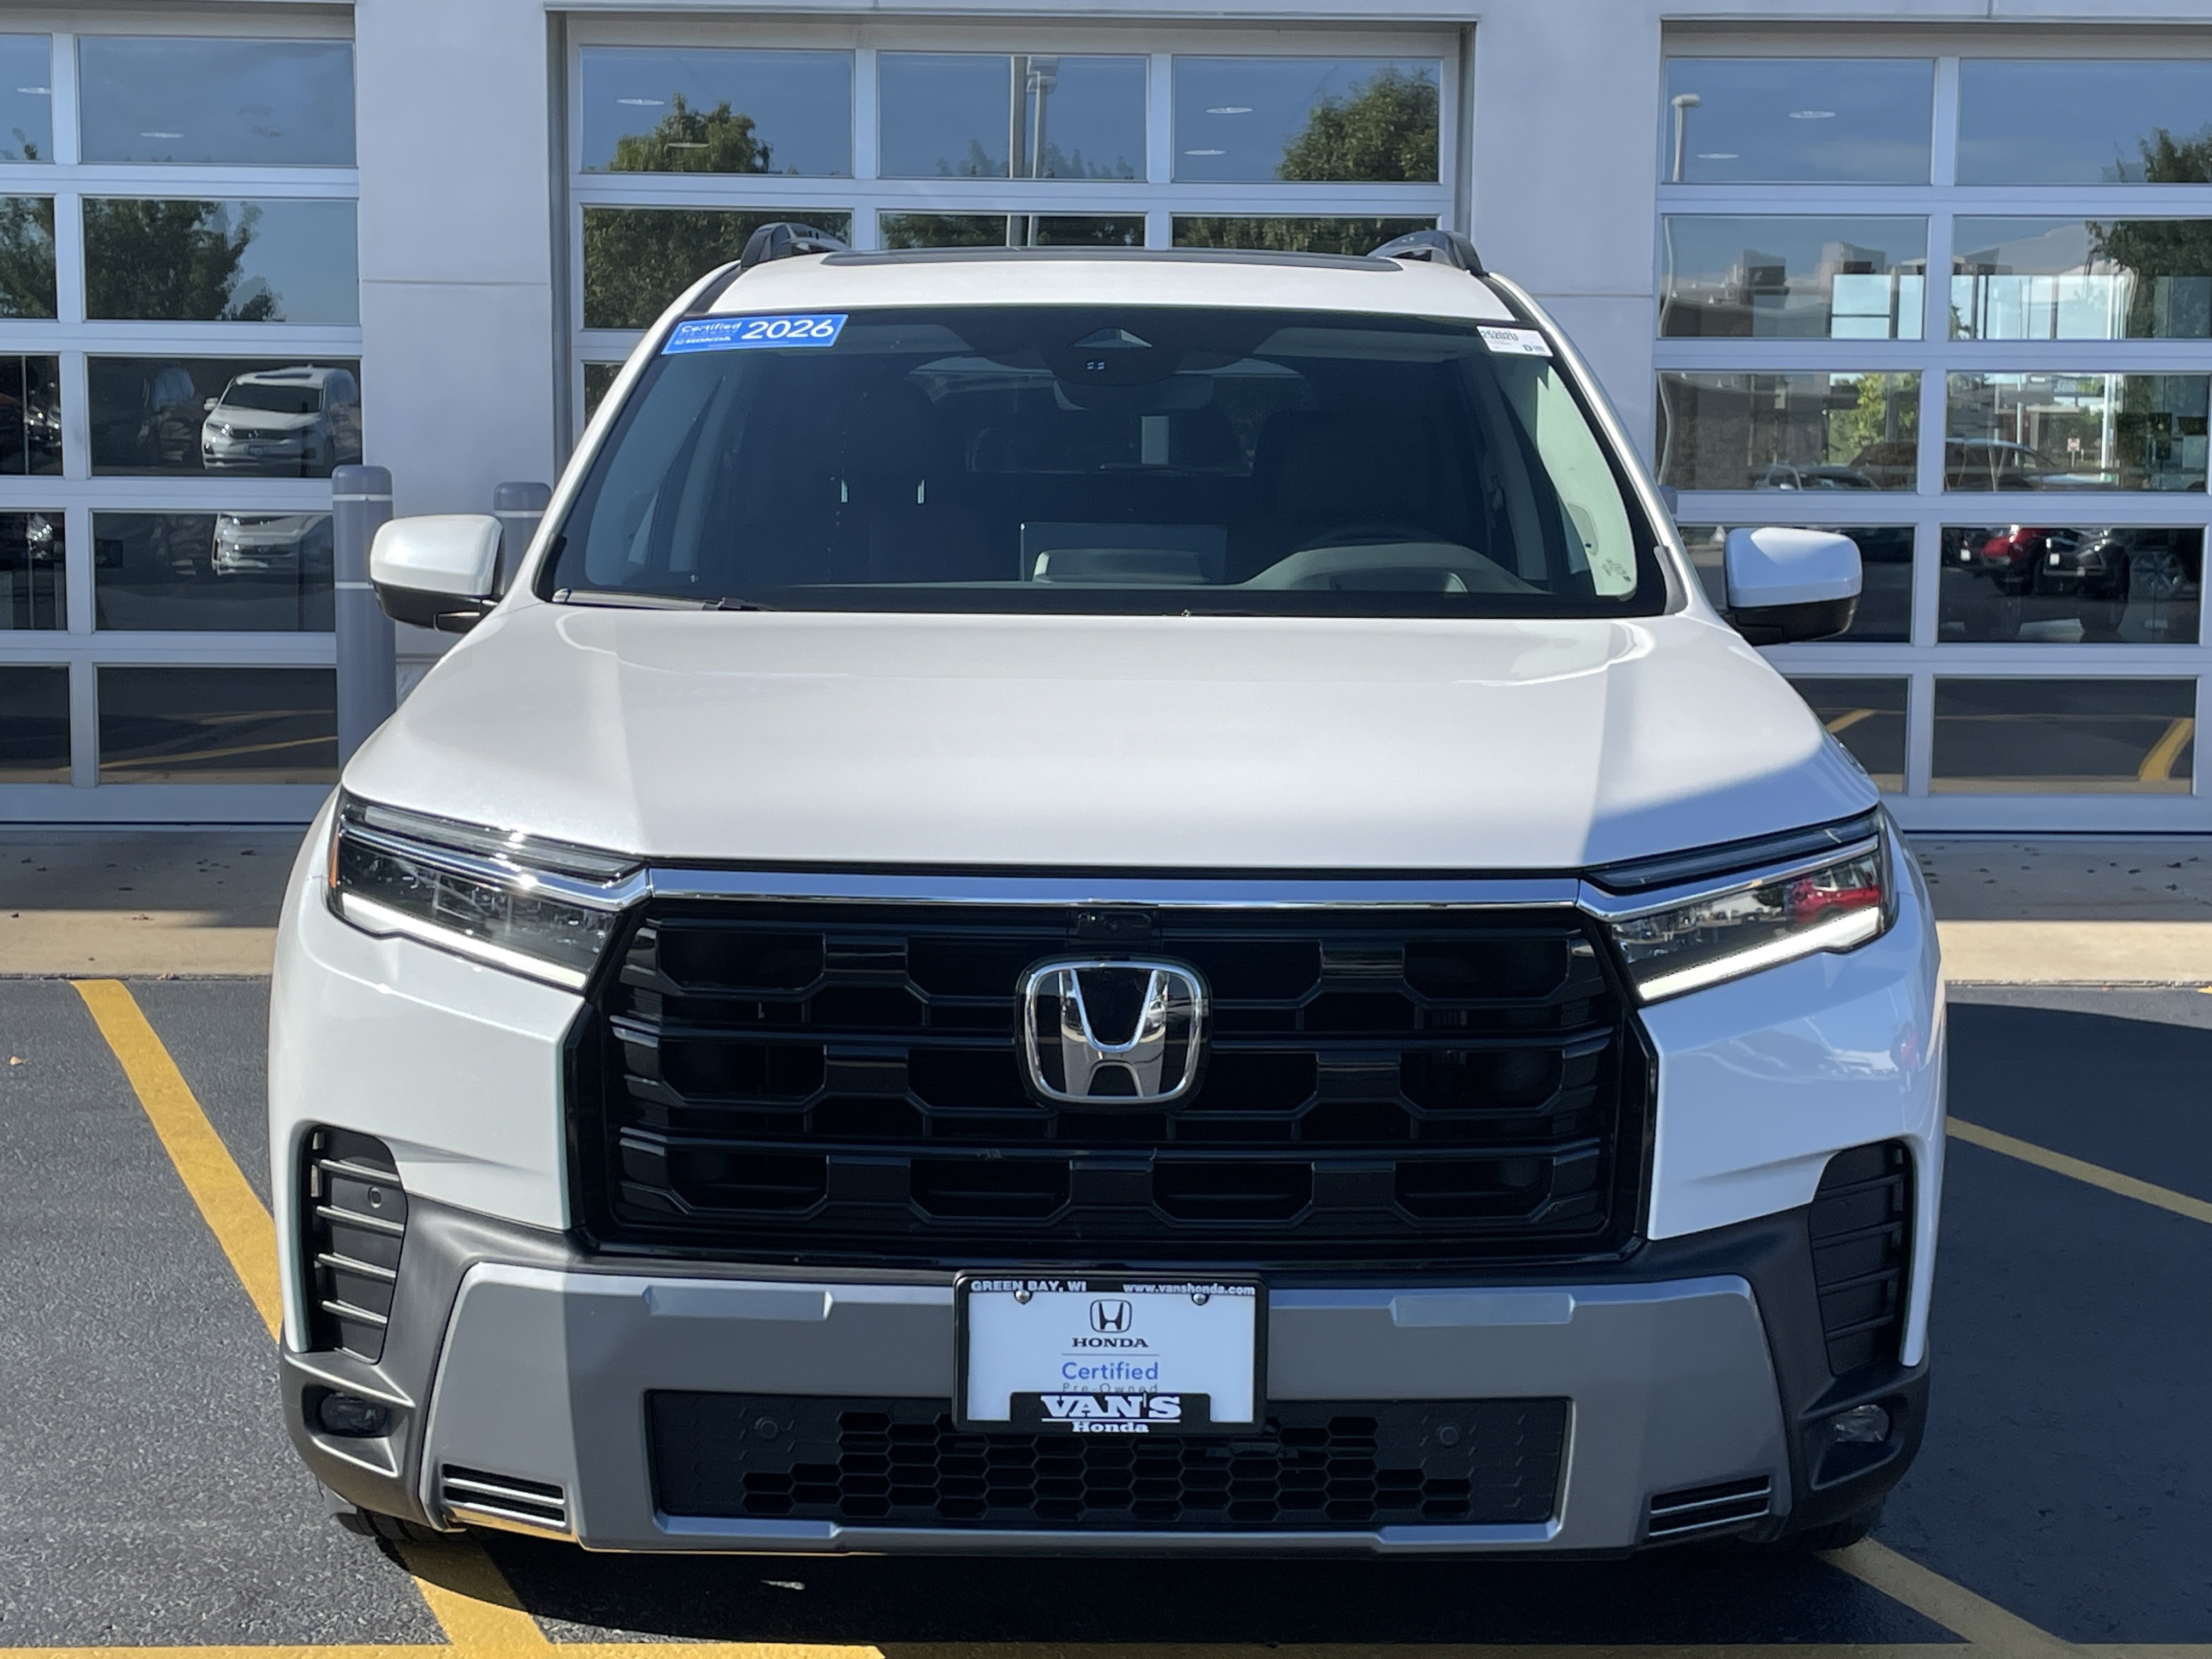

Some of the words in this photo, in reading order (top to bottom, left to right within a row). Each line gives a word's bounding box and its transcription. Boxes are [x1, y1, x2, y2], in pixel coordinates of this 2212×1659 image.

[682, 321, 742, 332] Certified
[741, 319, 834, 340] 2026
[970, 1280, 1023, 1291] GREEN
[1027, 1280, 1064, 1293] BAY,
[1067, 1280, 1087, 1292] WI
[1122, 1283, 1256, 1295] www.vanshonda.com
[1072, 1337, 1149, 1348] HONDA
[1062, 1361, 1158, 1380] Certified
[1063, 1382, 1158, 1392] Pre-Owned
[1040, 1392, 1182, 1418] VAN'S
[1073, 1421, 1149, 1433] Honda
